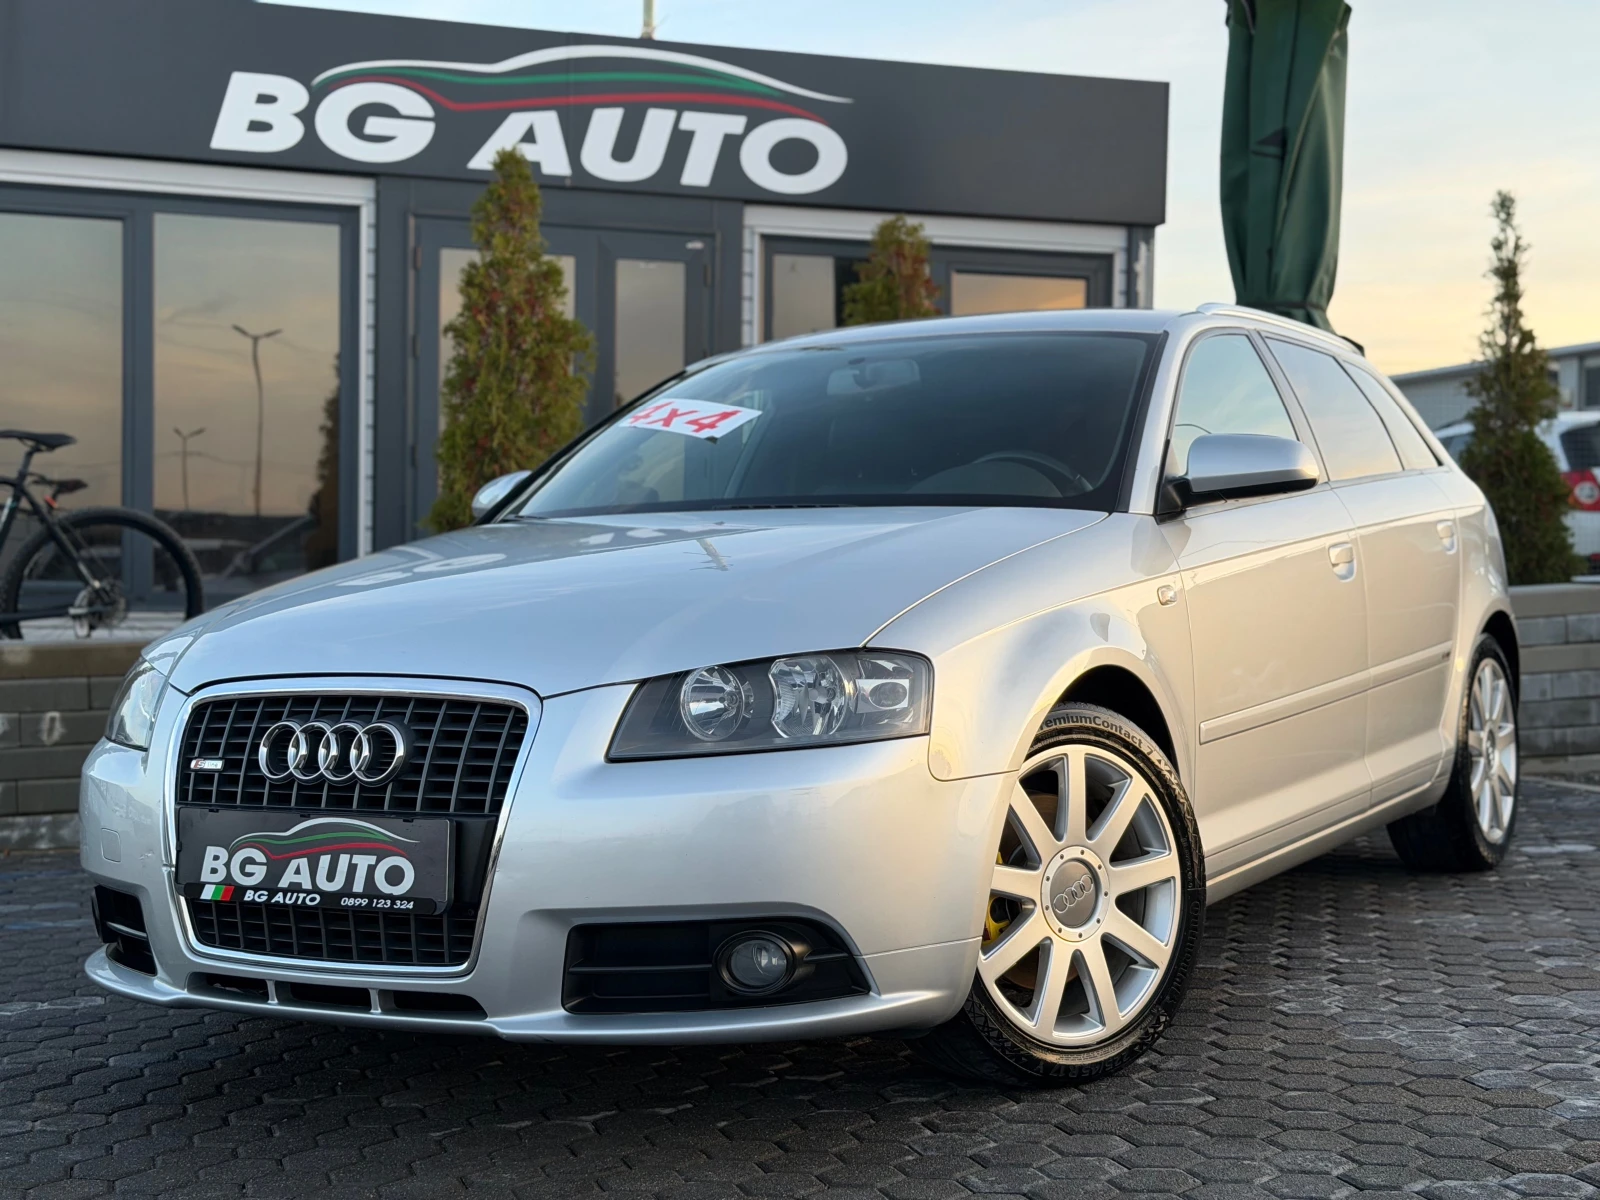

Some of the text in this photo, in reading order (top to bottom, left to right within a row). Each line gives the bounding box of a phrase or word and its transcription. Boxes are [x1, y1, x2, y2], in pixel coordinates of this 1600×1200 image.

[210, 71, 848, 194] BG AUTO
[1039, 714, 1142, 748] remiumContact
[201, 846, 415, 896] BG AUTO
[243, 890, 321, 905] BG AUTO
[341, 897, 414, 909] 0899 123 324
